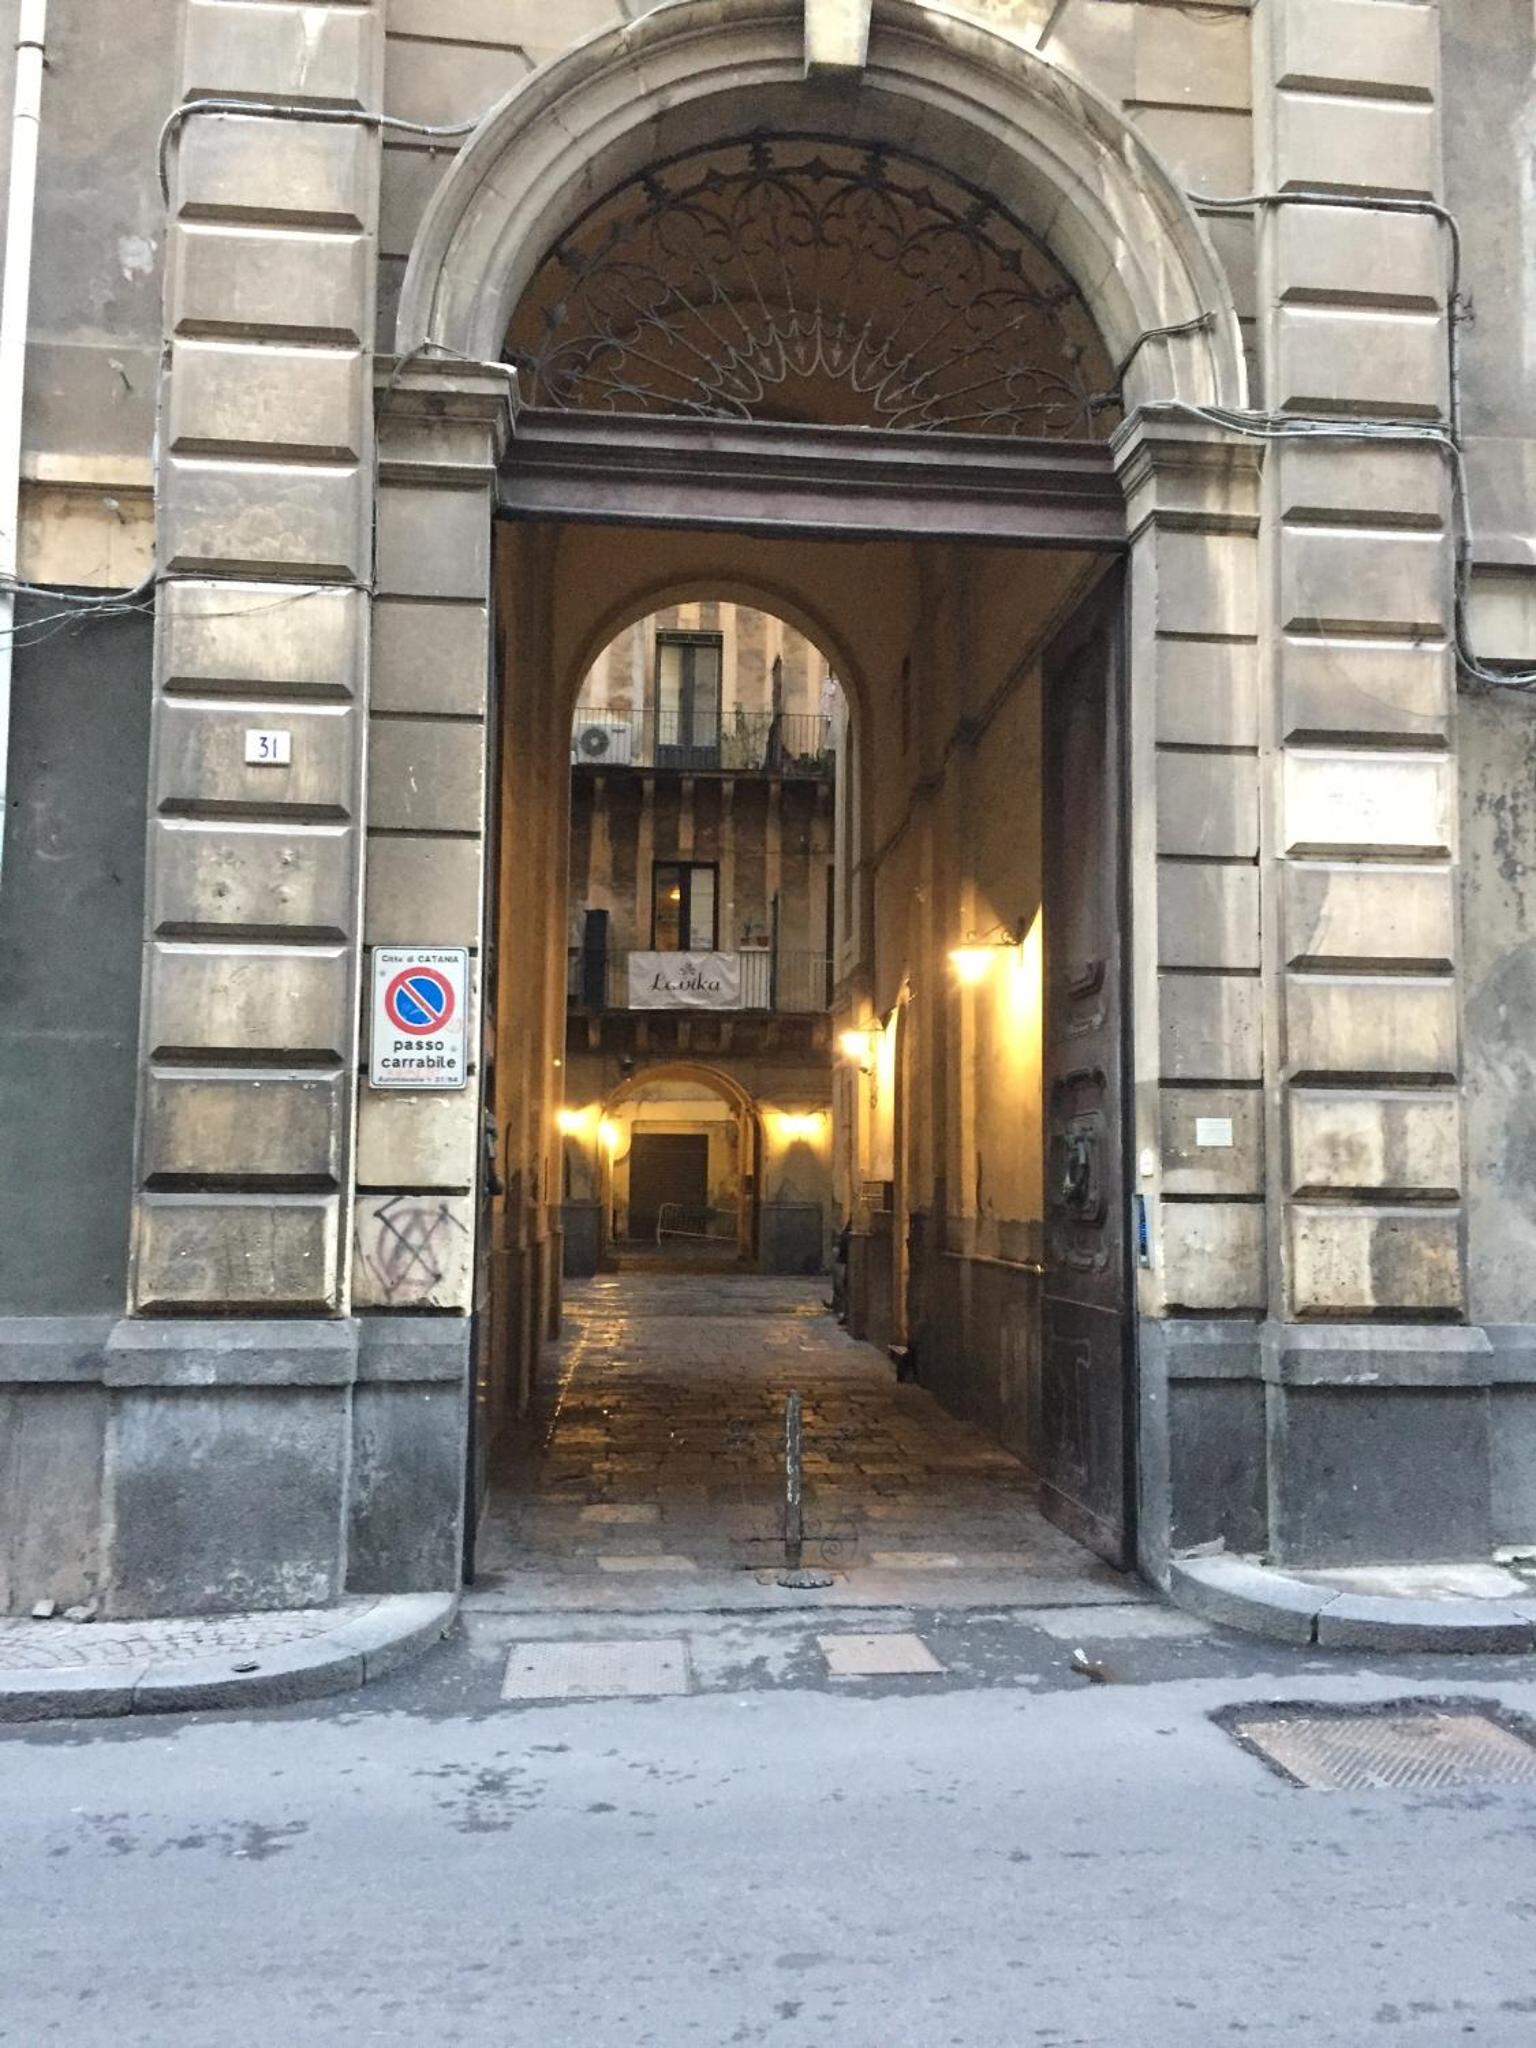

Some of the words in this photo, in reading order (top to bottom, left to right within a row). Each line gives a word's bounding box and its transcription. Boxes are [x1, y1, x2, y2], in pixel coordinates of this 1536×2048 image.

[259, 736, 277, 759] 31
[417, 954, 459, 963] CATANIA
[393, 1040, 444, 1053] passo
[381, 1056, 457, 1068] carrabile
